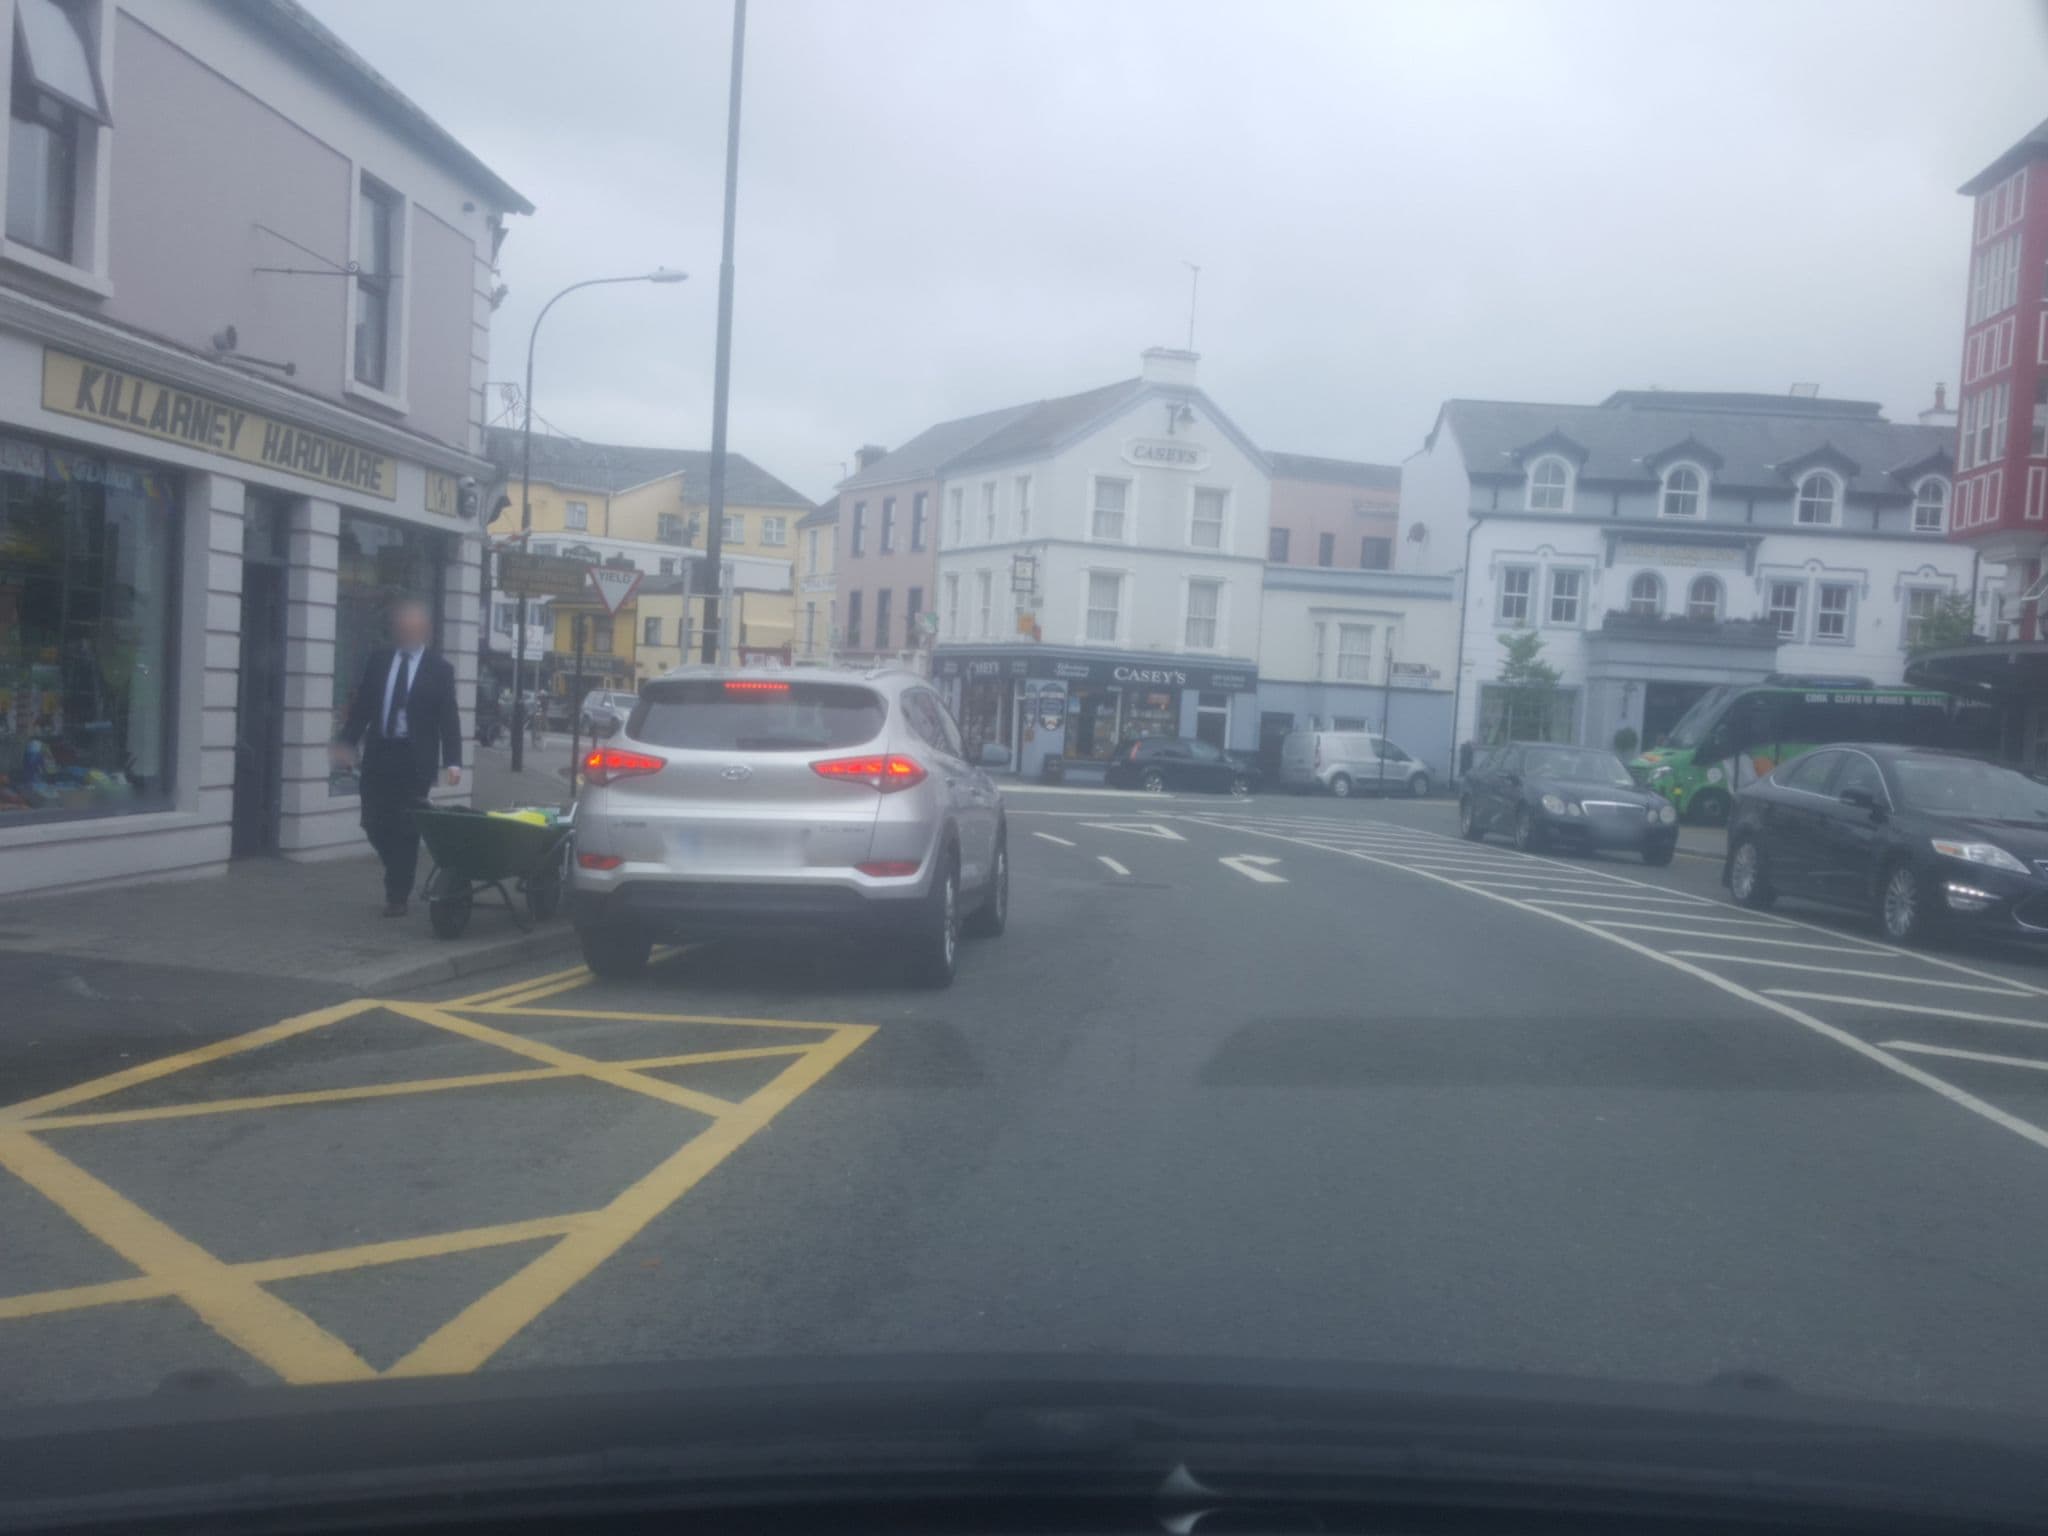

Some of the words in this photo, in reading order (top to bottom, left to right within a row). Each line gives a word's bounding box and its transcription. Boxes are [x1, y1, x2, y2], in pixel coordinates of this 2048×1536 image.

[75, 365, 244, 451] KILLARNEY
[261, 421, 383, 491] HARDWARE
[599, 571, 631, 584] YIELD
[1114, 666, 1187, 685] CASEY'S
